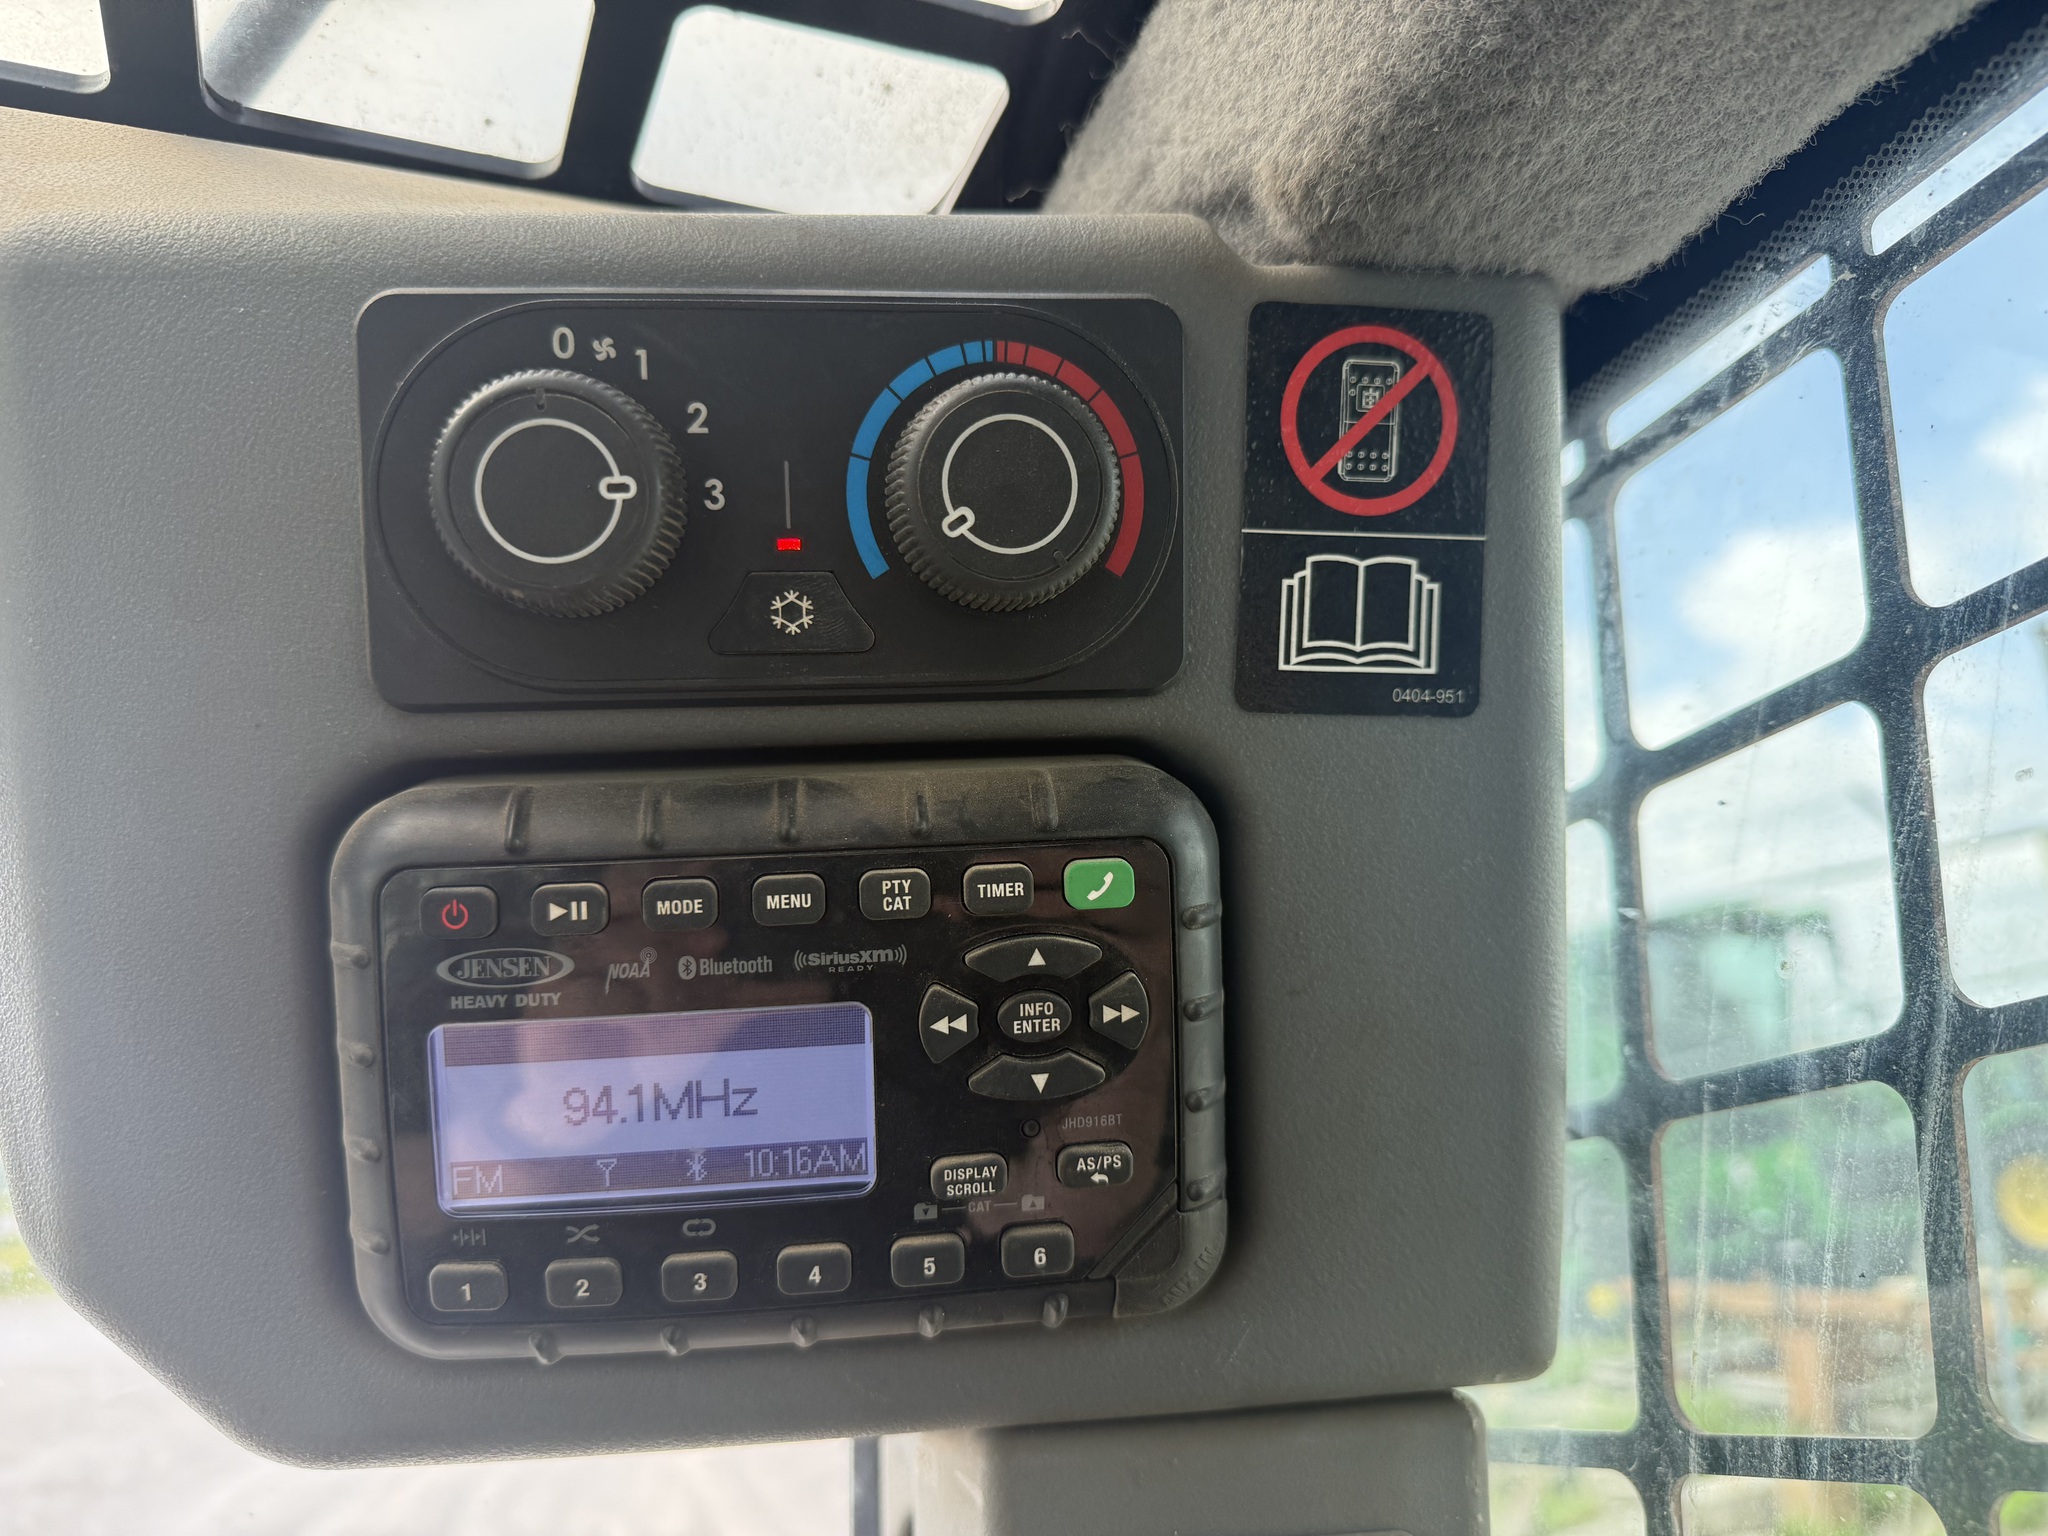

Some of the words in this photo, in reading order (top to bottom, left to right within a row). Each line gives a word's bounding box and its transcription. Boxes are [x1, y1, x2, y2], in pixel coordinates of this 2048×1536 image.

[552, 326, 575, 360] 0
[635, 349, 649, 381] 1
[687, 402, 709, 434] 2
[704, 478, 727, 511] 3
[1392, 688, 1464, 703] 0404-951
[881, 878, 911, 895] PTY
[977, 881, 1025, 898] TIMER
[656, 899, 704, 916] MODE
[766, 893, 812, 911] MENU
[882, 895, 912, 911] CAT
[456, 955, 553, 980] JENSEN
[605, 959, 652, 991] NOAA
[700, 955, 774, 977] Bluetooth
[828, 963, 875, 974] READY
[450, 993, 510, 1010] HEAVY
[515, 991, 563, 1007] DUTY
[1019, 1001, 1055, 1018] INFO
[1012, 1017, 1061, 1034] ENTER
[562, 1078, 759, 1127] 94.1MHz
[1061, 1113, 1123, 1130] JHD916BT
[743, 1142, 868, 1179] 10:16AM
[1076, 1154, 1122, 1172] AS/PS
[451, 1164, 504, 1196] FM
[943, 1165, 998, 1182] DISPLAY
[945, 1181, 996, 1197] SCROLL
[967, 1199, 992, 1214] CAT
[923, 1256, 936, 1276] 5
[1034, 1247, 1047, 1267] 6
[693, 1272, 708, 1291] 3
[808, 1264, 822, 1284] 4
[461, 1282, 473, 1301] 1
[576, 1278, 591, 1298] 2
